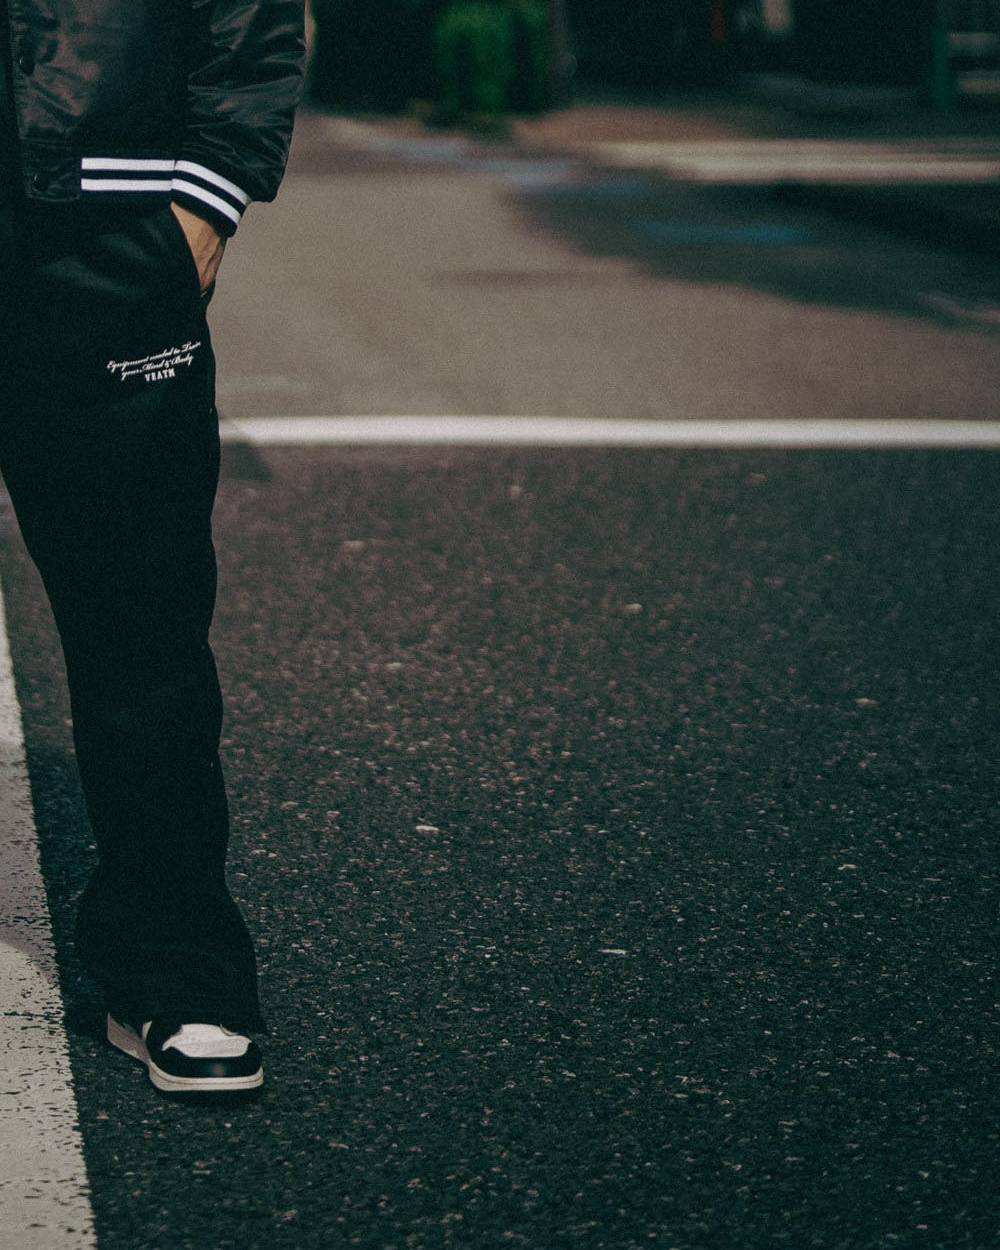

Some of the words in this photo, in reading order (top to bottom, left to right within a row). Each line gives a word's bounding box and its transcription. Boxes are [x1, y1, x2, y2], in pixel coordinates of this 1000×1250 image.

[107, 355, 150, 373] Equipment
[149, 347, 174, 360] needed
[142, 359, 165, 371] Mind
